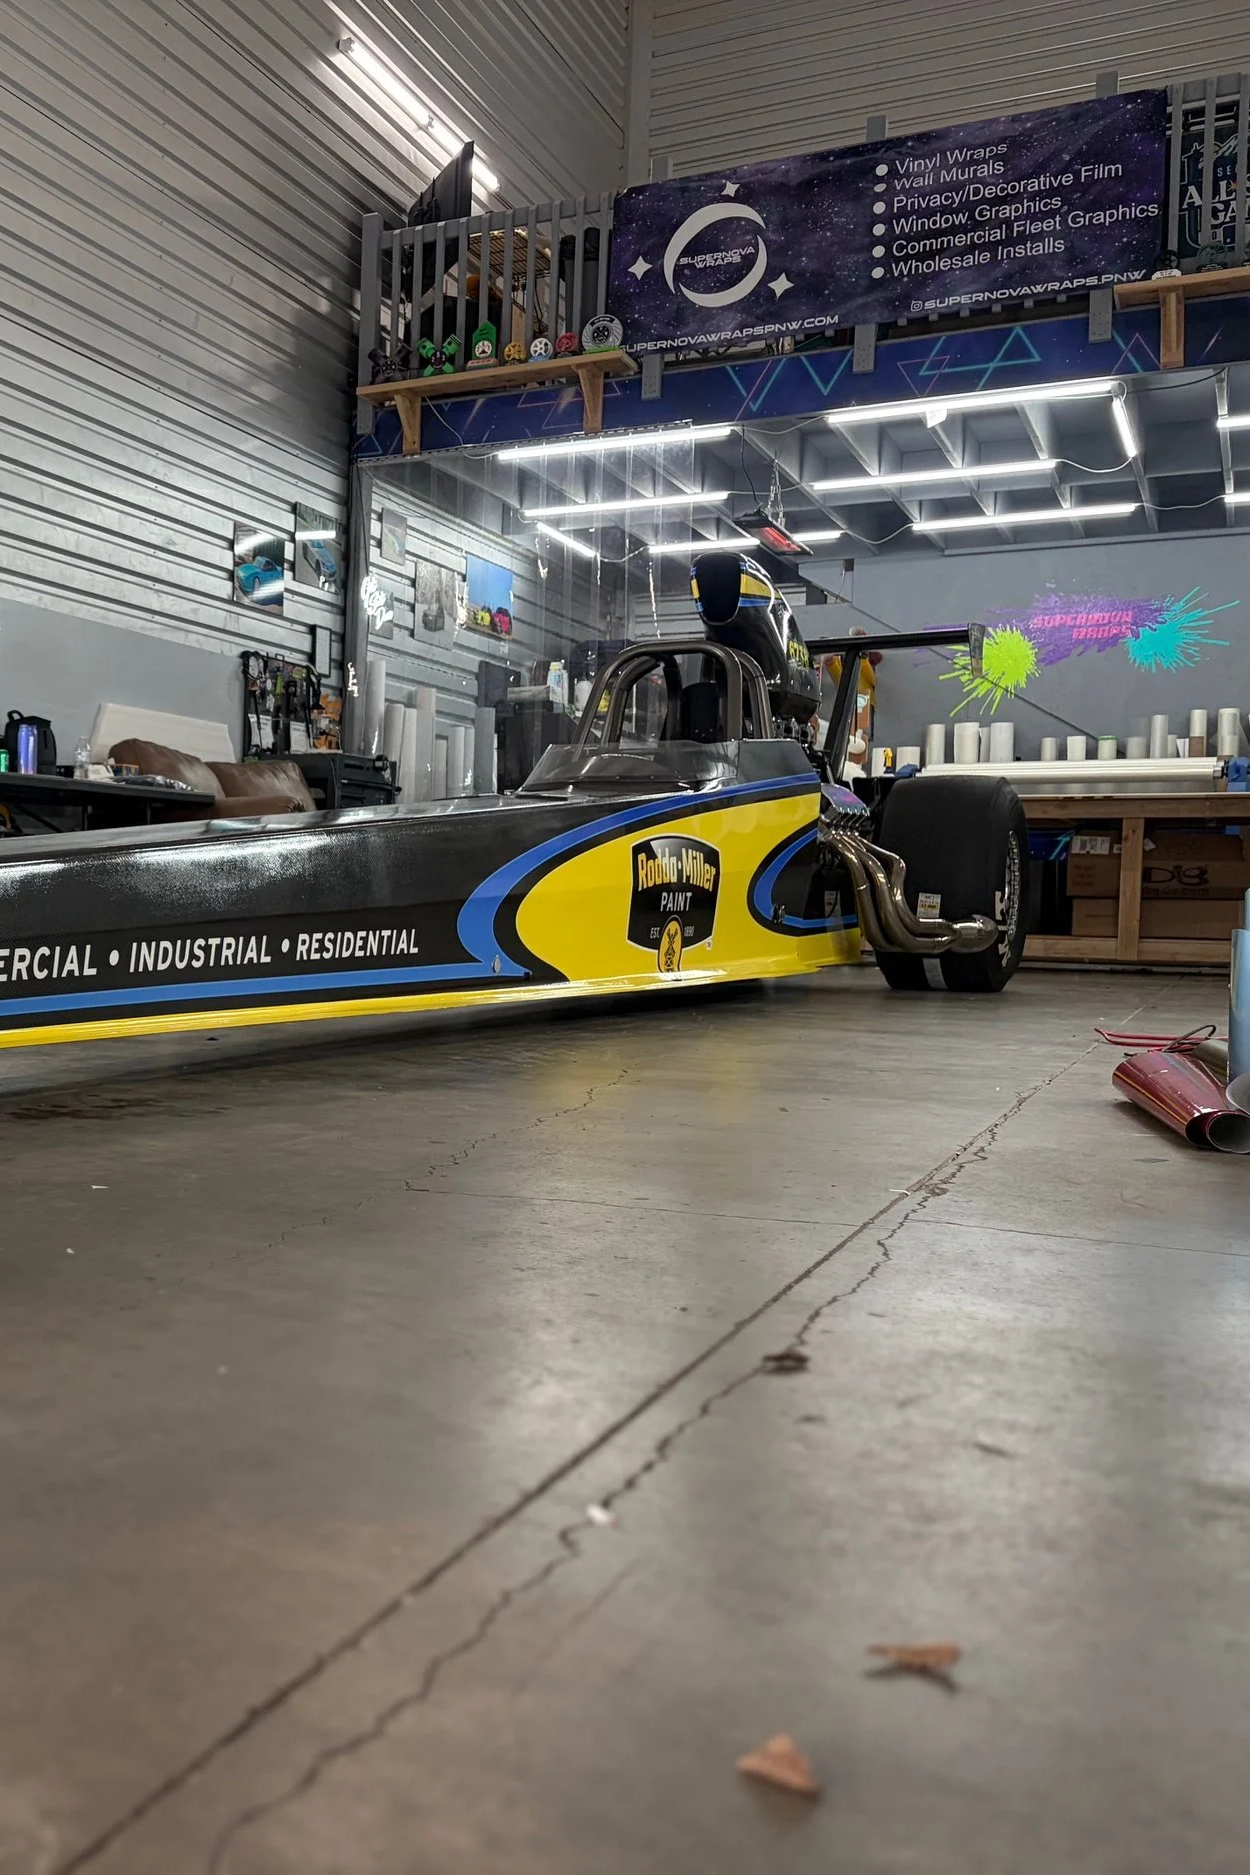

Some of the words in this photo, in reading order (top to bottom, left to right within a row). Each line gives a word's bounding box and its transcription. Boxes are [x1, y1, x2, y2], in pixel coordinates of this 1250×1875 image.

[894, 173, 933, 191] Wall
[940, 159, 1005, 182] Murals
[896, 153, 940, 175] Vinyl
[947, 142, 1008, 165] Wraps
[894, 171, 1073, 213] Privacy/Decorative
[1081, 162, 1122, 182] Film
[893, 211, 968, 235] Window
[975, 195, 1062, 223] Graphics
[893, 223, 1006, 257] Commercial
[1013, 214, 1061, 237] Fleet
[1068, 202, 1159, 231] Graphics
[679, 246, 755, 265] SUPERNOVA
[695, 255, 742, 269] WRAPS
[892, 250, 990, 277] Wholesale
[997, 237, 1065, 260] Installs
[660, 891, 693, 912] PAINT
[129, 935, 272, 973] INDUSTRIAL
[295, 928, 419, 961] RESIDENTIAL
